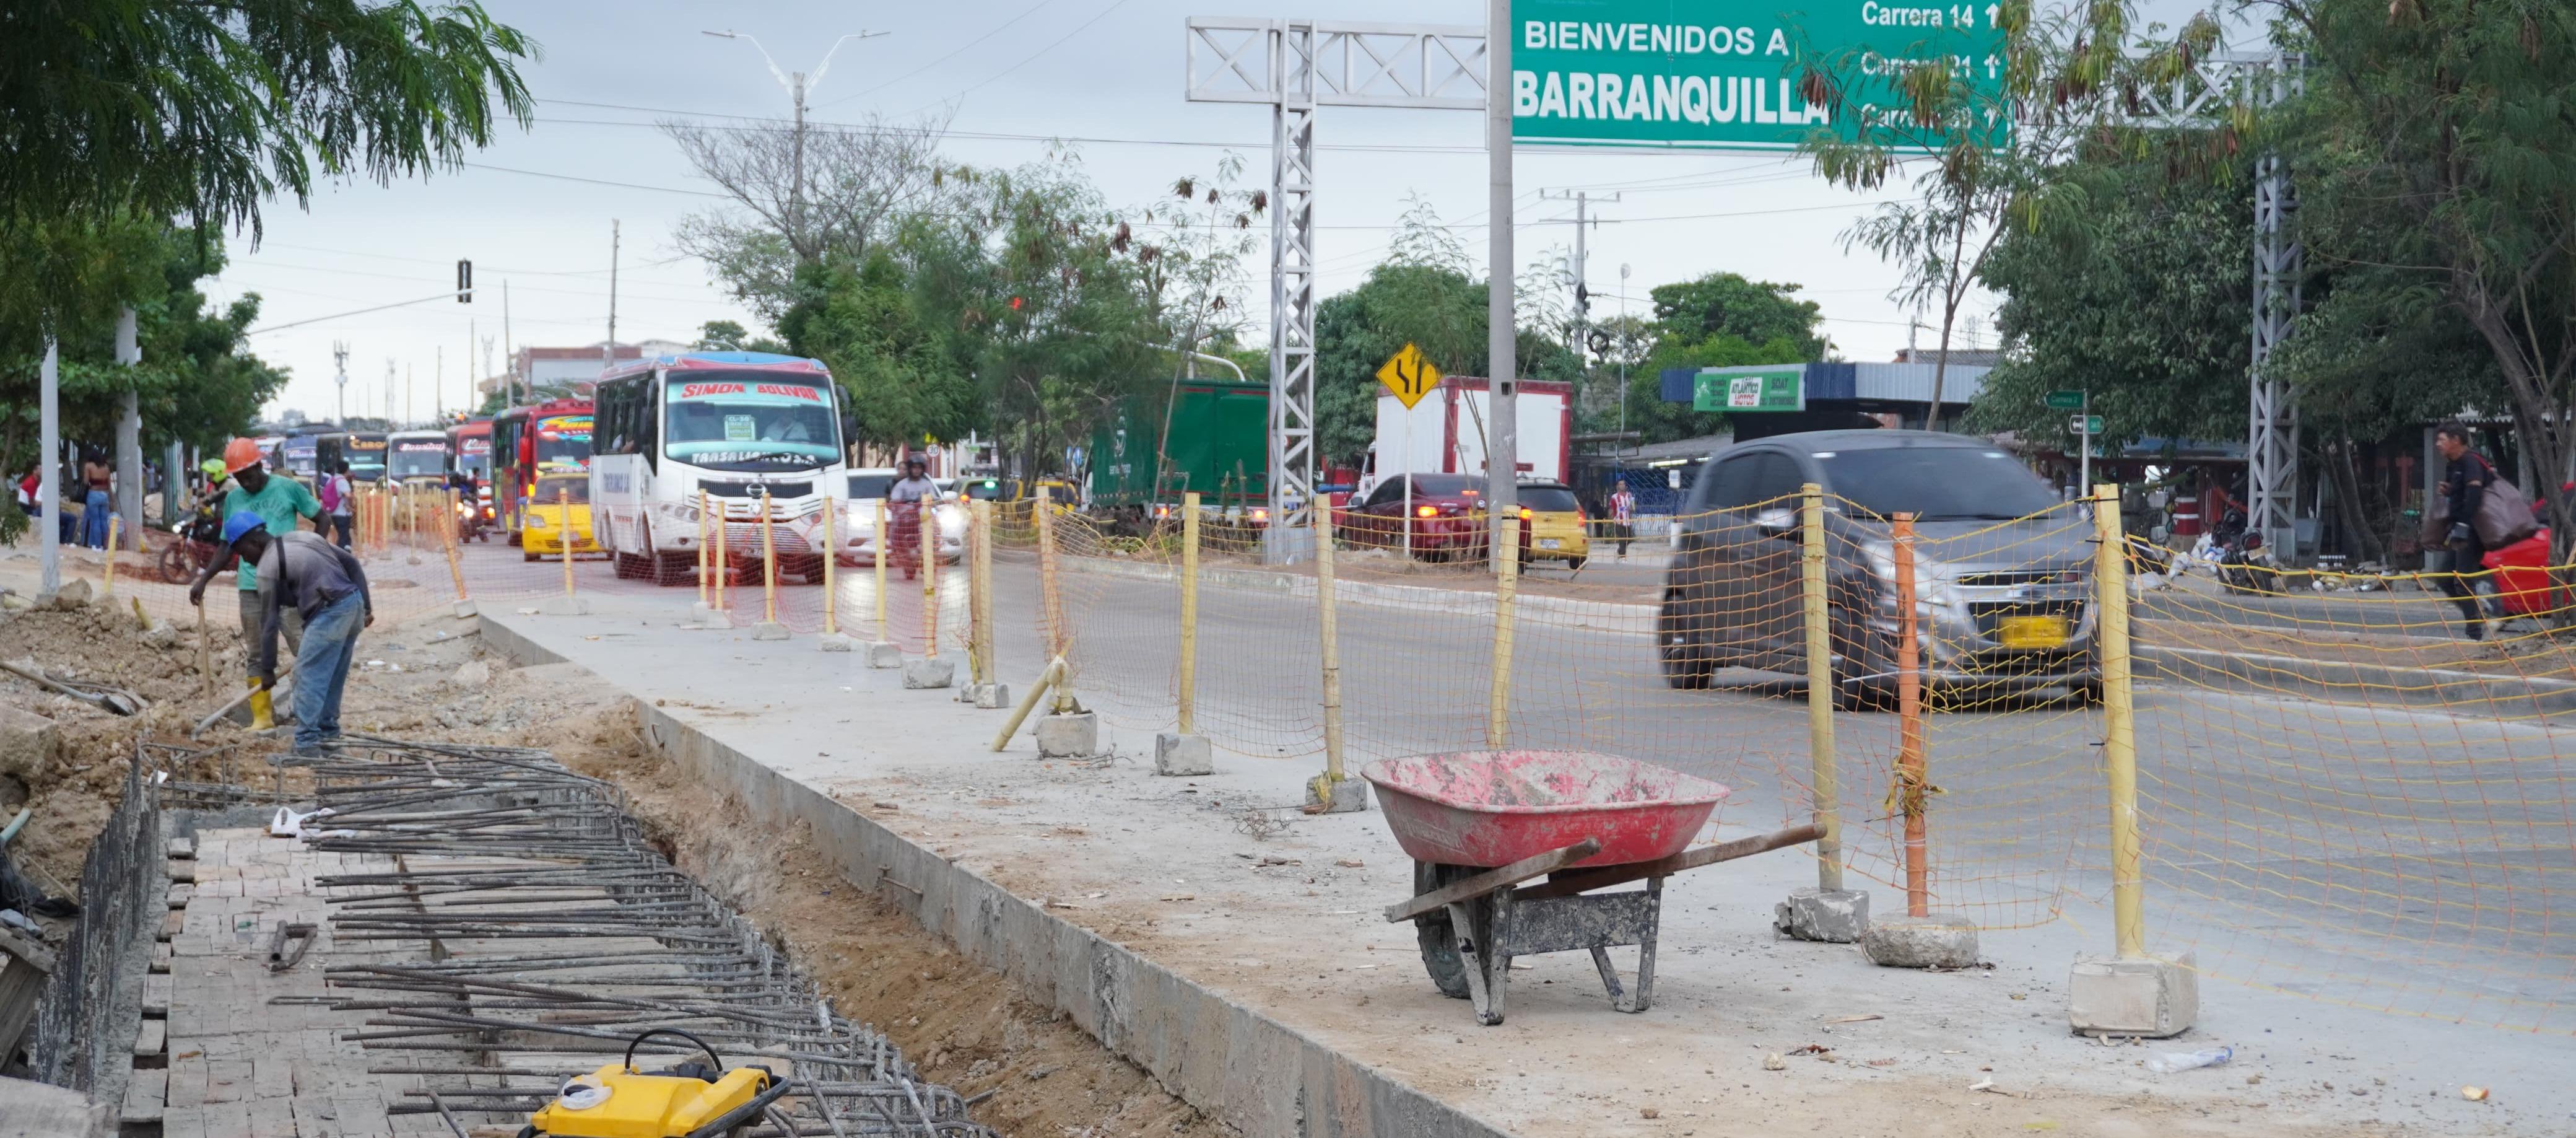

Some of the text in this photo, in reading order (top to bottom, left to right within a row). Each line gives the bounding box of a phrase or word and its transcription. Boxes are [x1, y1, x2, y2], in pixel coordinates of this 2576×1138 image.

[1862, 1, 1974, 28] Carrera 14
[1525, 20, 1789, 56] BIENVENIDOS A
[1513, 70, 1830, 126] BARRANQUILLA
[682, 382, 822, 402] SIMON BOLIVAR
